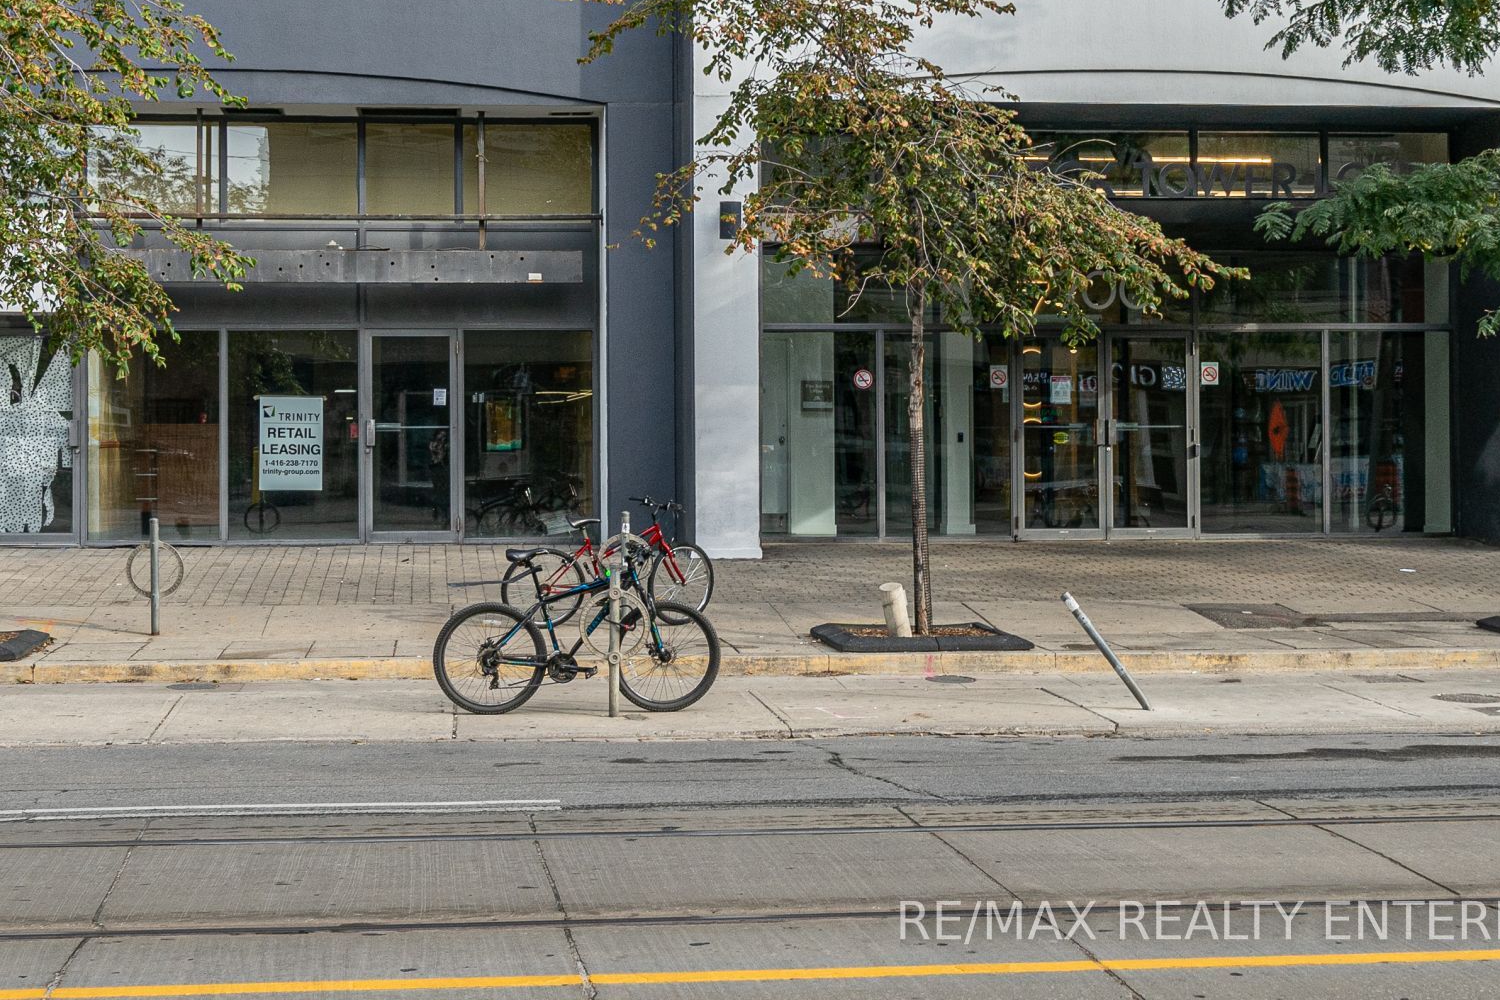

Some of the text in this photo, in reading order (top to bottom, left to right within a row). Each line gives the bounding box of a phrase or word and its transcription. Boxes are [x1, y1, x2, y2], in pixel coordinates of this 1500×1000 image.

[1133, 160, 1299, 199] TOWER
[1055, 269, 1157, 310] 00
[278, 412, 320, 421] TRINITY
[267, 427, 317, 439] RETAIL
[262, 444, 320, 455] LEASING
[265, 459, 319, 467] 1-416-238-7170
[262, 468, 320, 476] trinity-group.com
